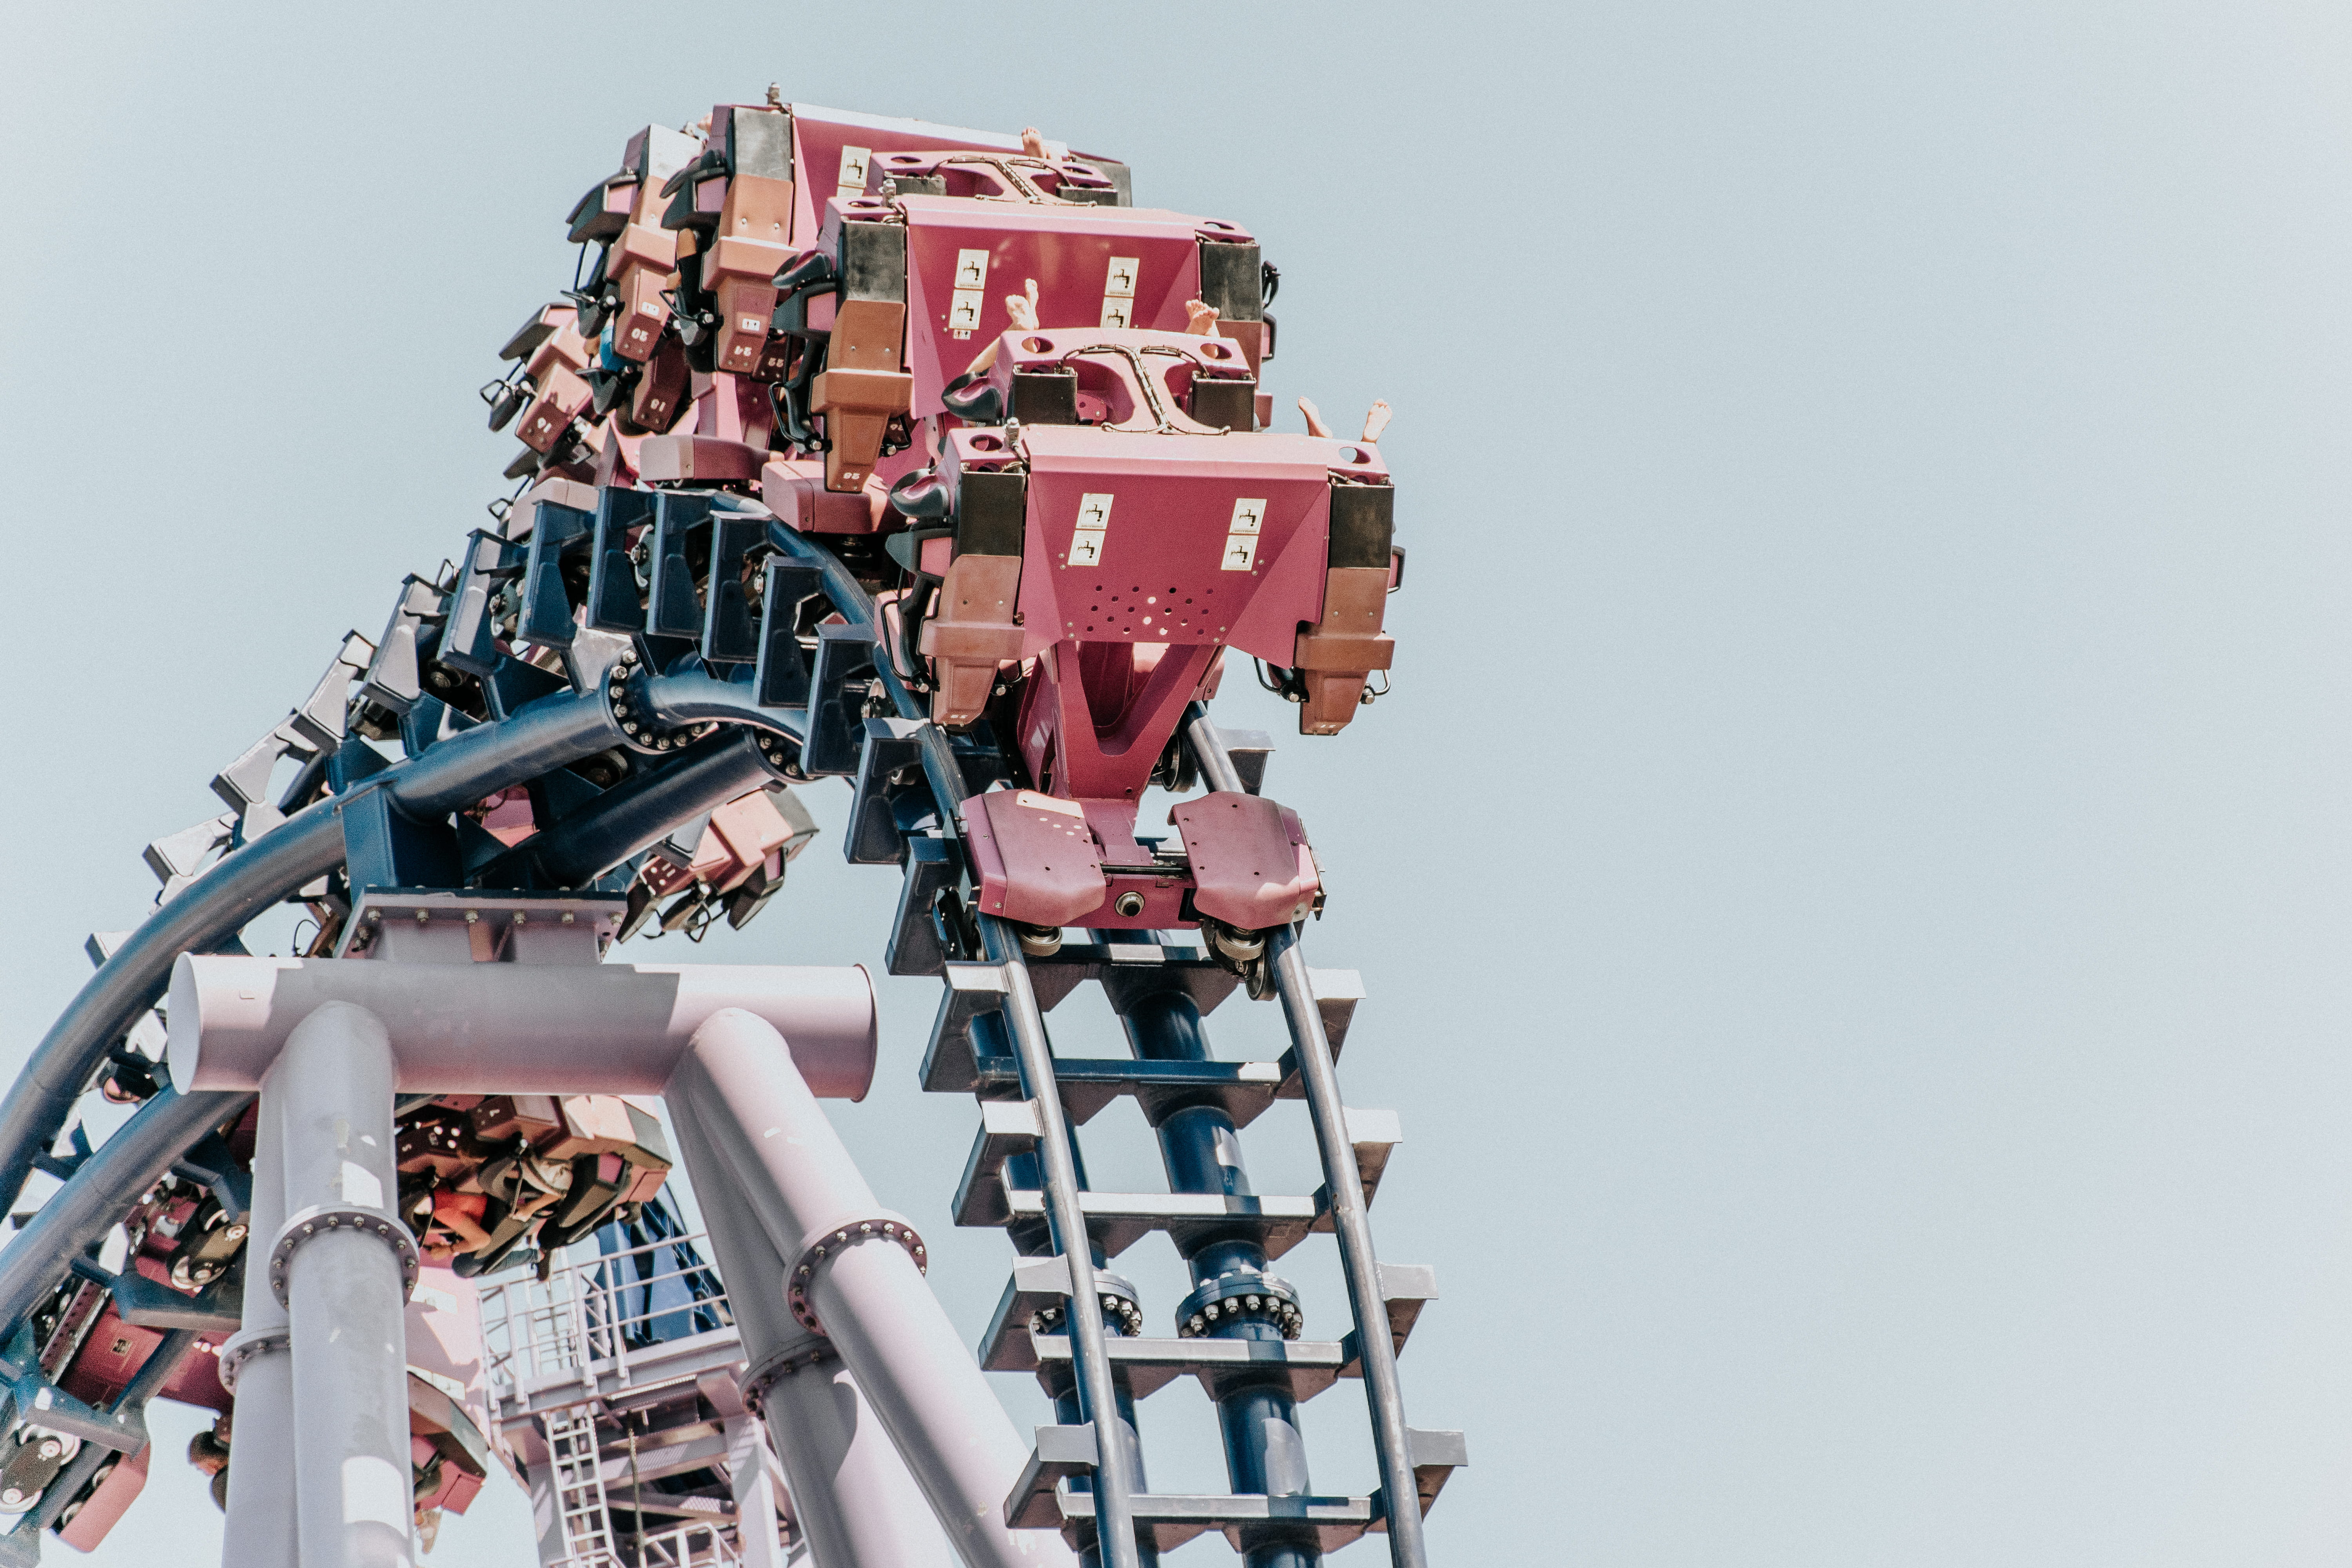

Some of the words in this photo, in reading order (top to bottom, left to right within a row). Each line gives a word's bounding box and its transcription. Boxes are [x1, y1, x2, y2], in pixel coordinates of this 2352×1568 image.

[632, 328, 648, 341] 20
[734, 346, 752, 356] 24
[768, 358, 784, 367] 22
[651, 399, 666, 412] 18
[537, 417, 552, 433] 16
